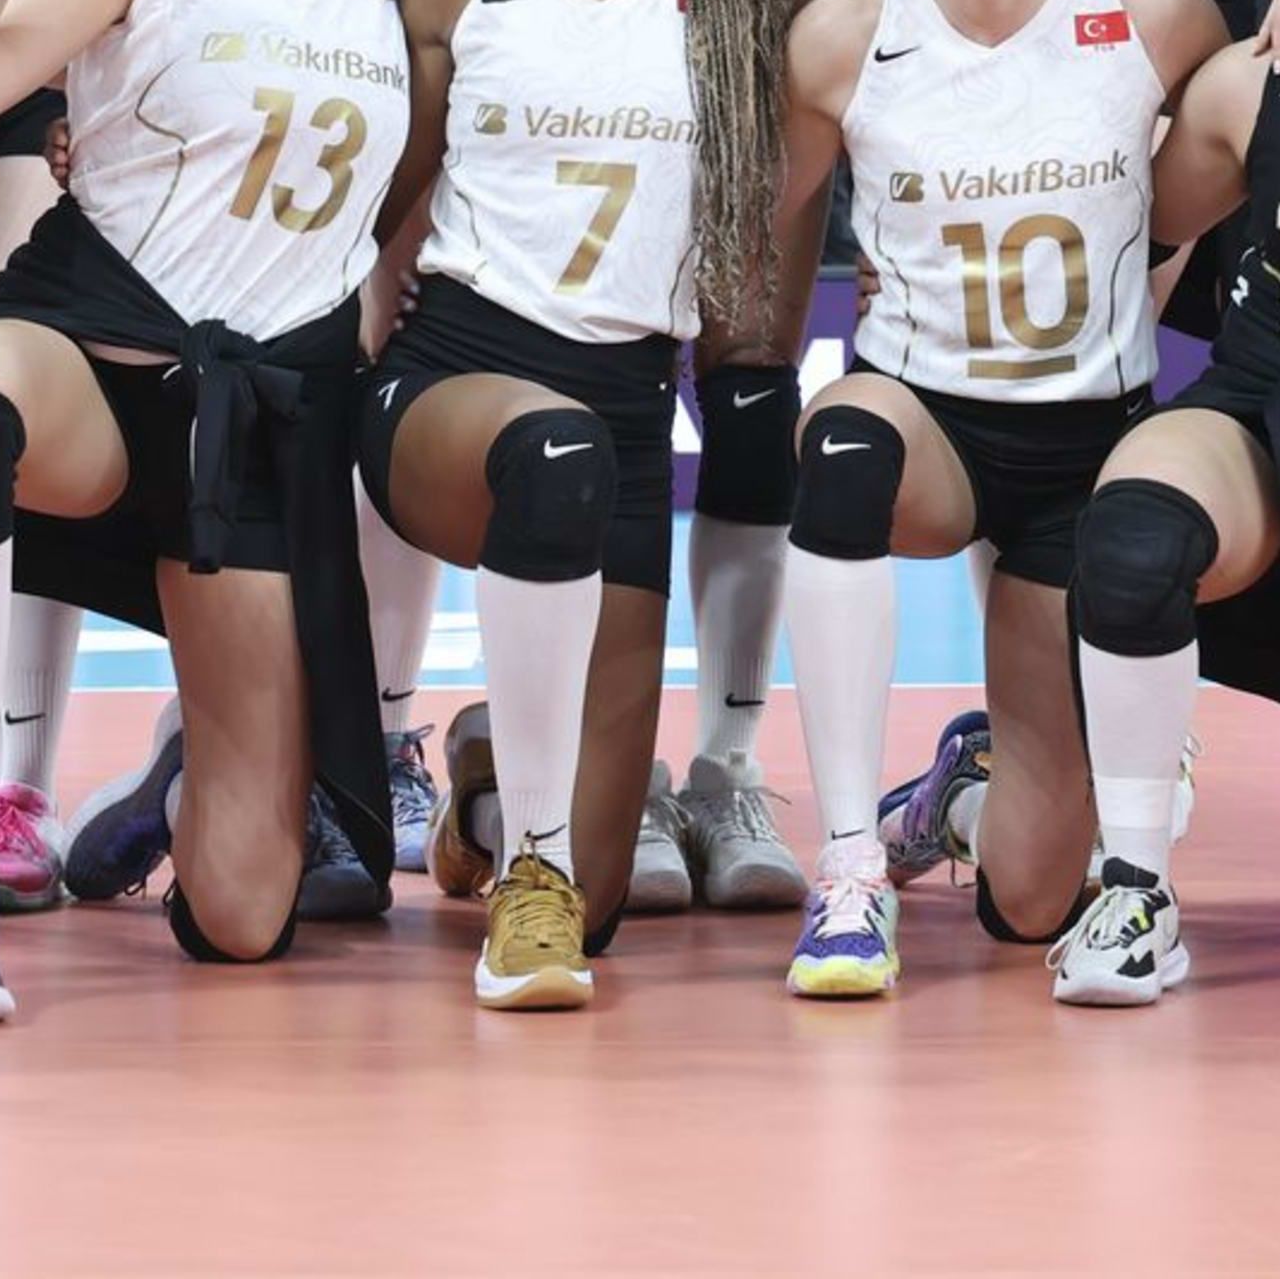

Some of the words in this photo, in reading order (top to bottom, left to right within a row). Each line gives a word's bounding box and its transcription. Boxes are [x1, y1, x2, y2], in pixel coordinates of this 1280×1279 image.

[228, 87, 368, 234] 13
[553, 161, 638, 296] 7
[941, 213, 1090, 350] 10
